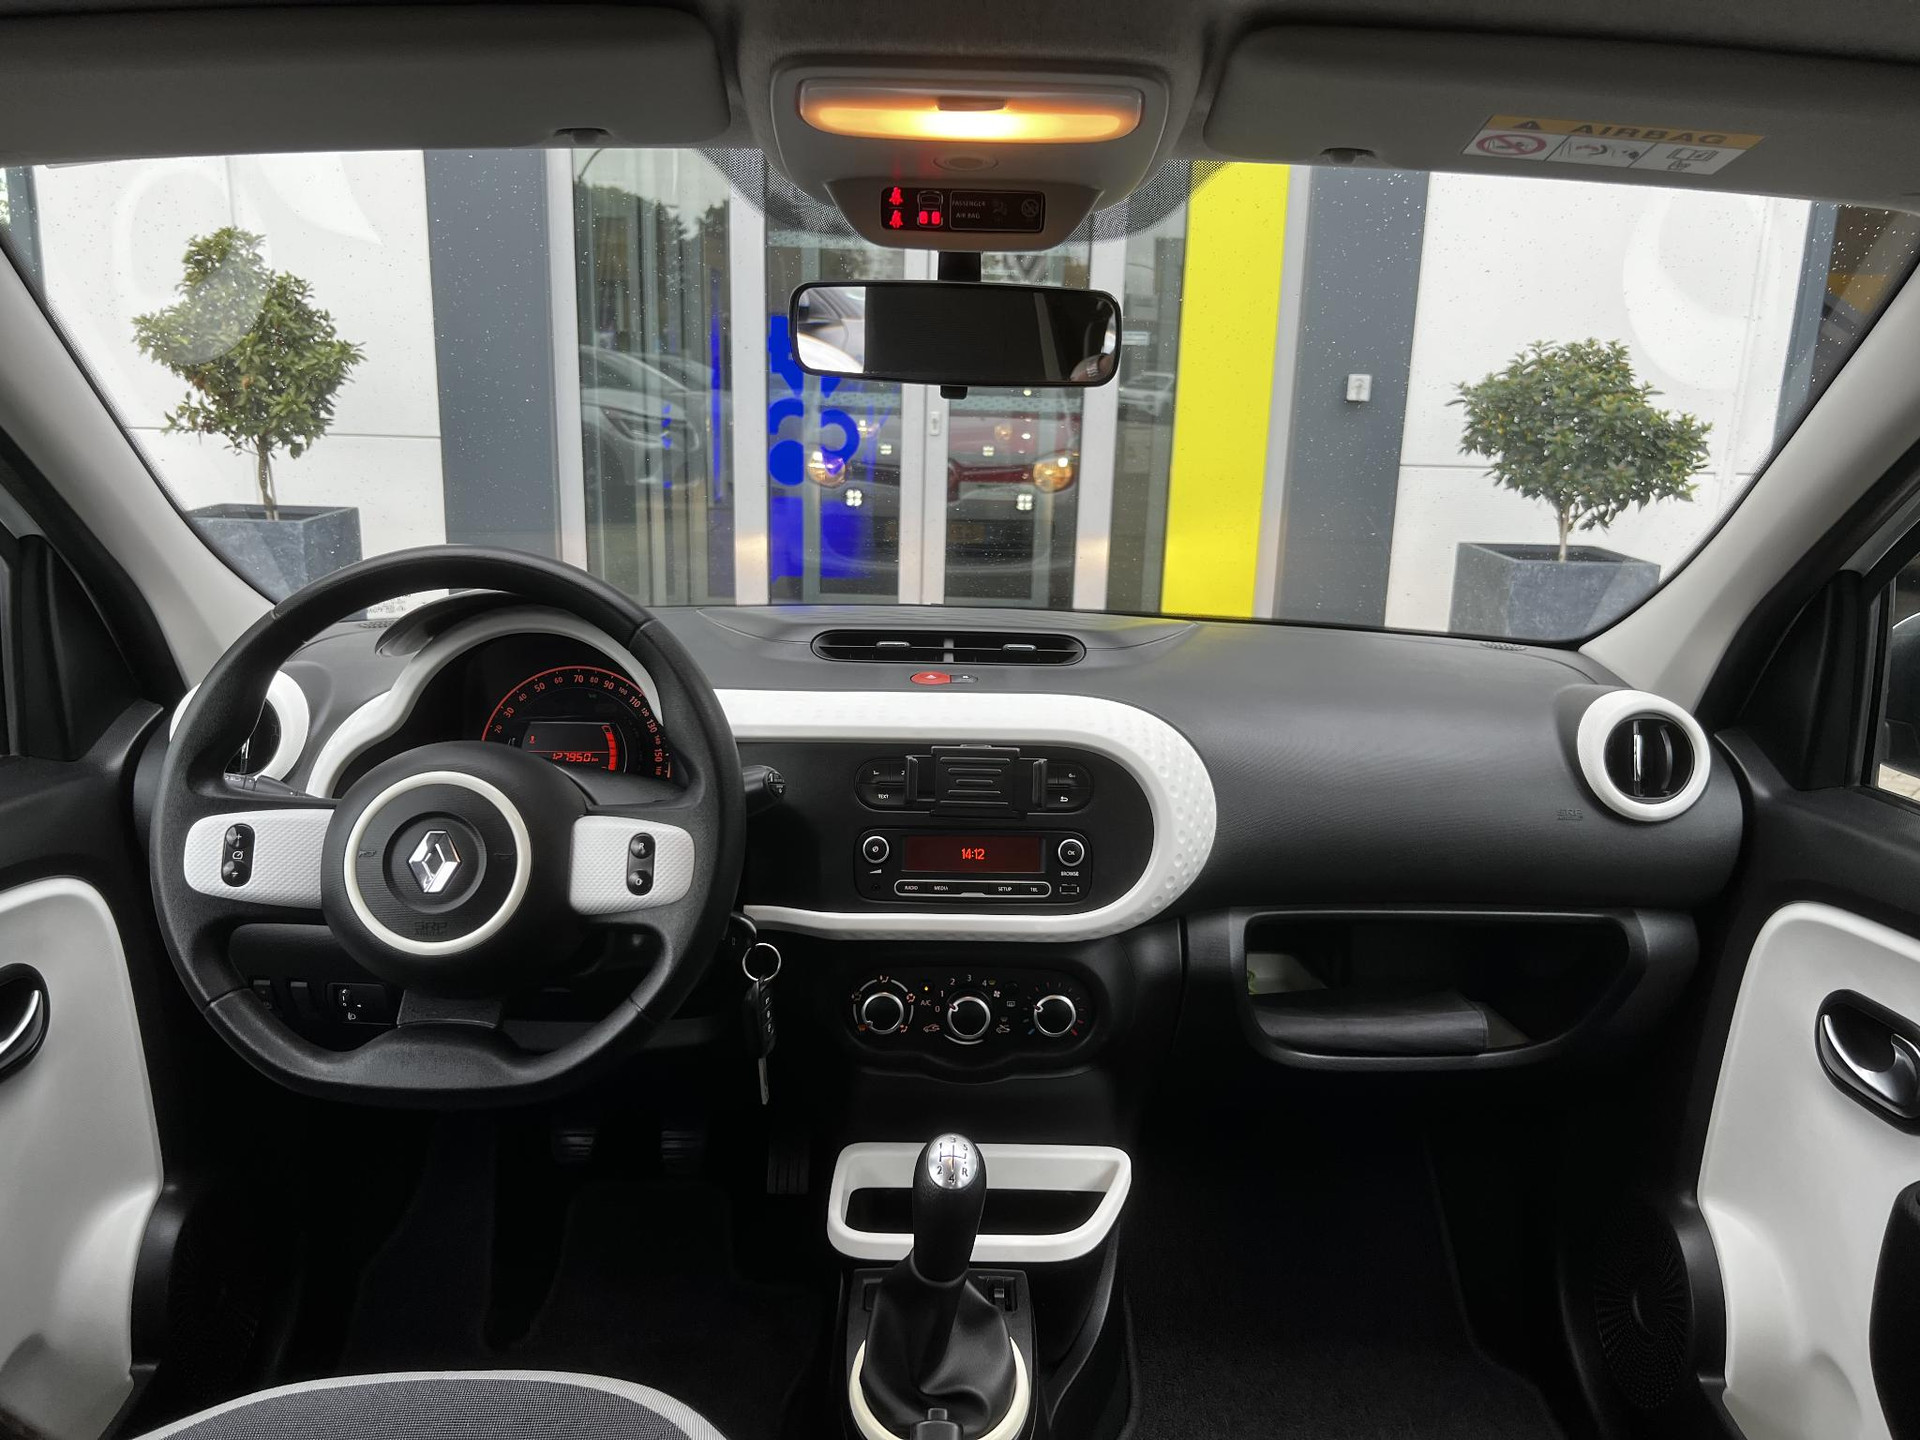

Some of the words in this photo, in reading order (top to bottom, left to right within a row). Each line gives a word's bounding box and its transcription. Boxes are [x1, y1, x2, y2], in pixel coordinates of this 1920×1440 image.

[1571, 124, 1727, 145] AIRBAG
[554, 676, 564, 684] 60
[573, 674, 584, 684] 70
[589, 676, 599, 684] 80
[602, 678, 615, 690] 90
[533, 682, 546, 694] 50
[618, 686, 628, 696] 100
[518, 692, 528, 702] 40
[628, 695, 642, 708] 110
[502, 706, 515, 718] 30
[640, 706, 650, 718] 120
[646, 718, 658, 734] 130
[552, 752, 592, 762] 127950
[654, 748, 664, 762] 150
[961, 848, 985, 860] 14:12
[936, 1166, 943, 1175] 2
[962, 1168, 968, 1177] R
[948, 1174, 956, 1184] 4
